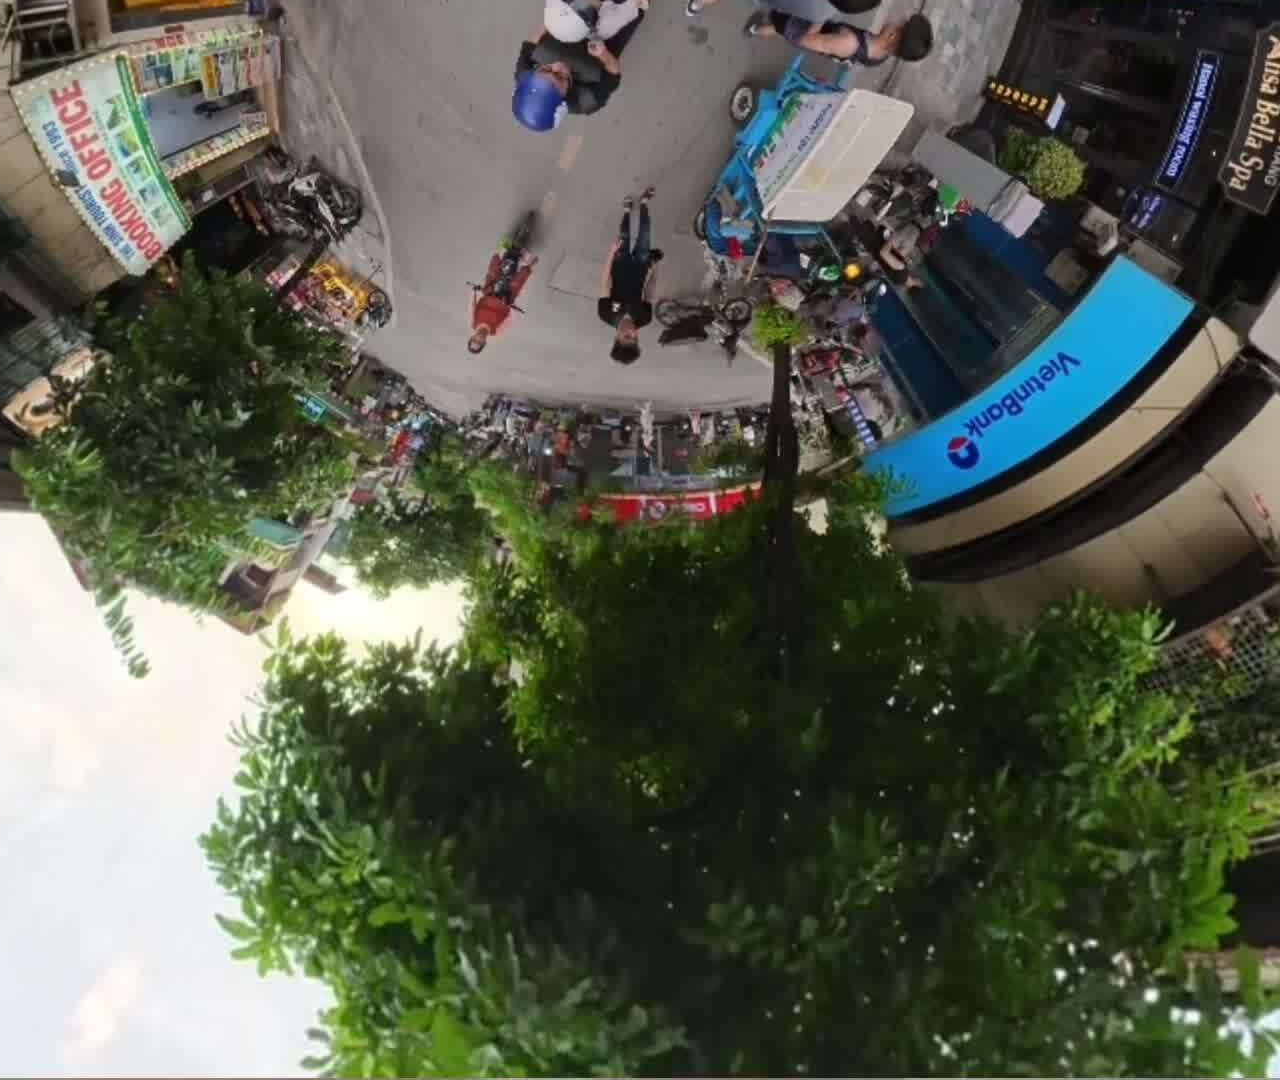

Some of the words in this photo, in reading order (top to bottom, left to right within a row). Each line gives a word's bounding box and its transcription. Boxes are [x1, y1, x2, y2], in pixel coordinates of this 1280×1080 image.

[49, 79, 113, 182] OFFICE
[1228, 152, 1265, 192] Spa
[99, 177, 163, 261] BOOKING
[962, 351, 1081, 438] VietinBank
